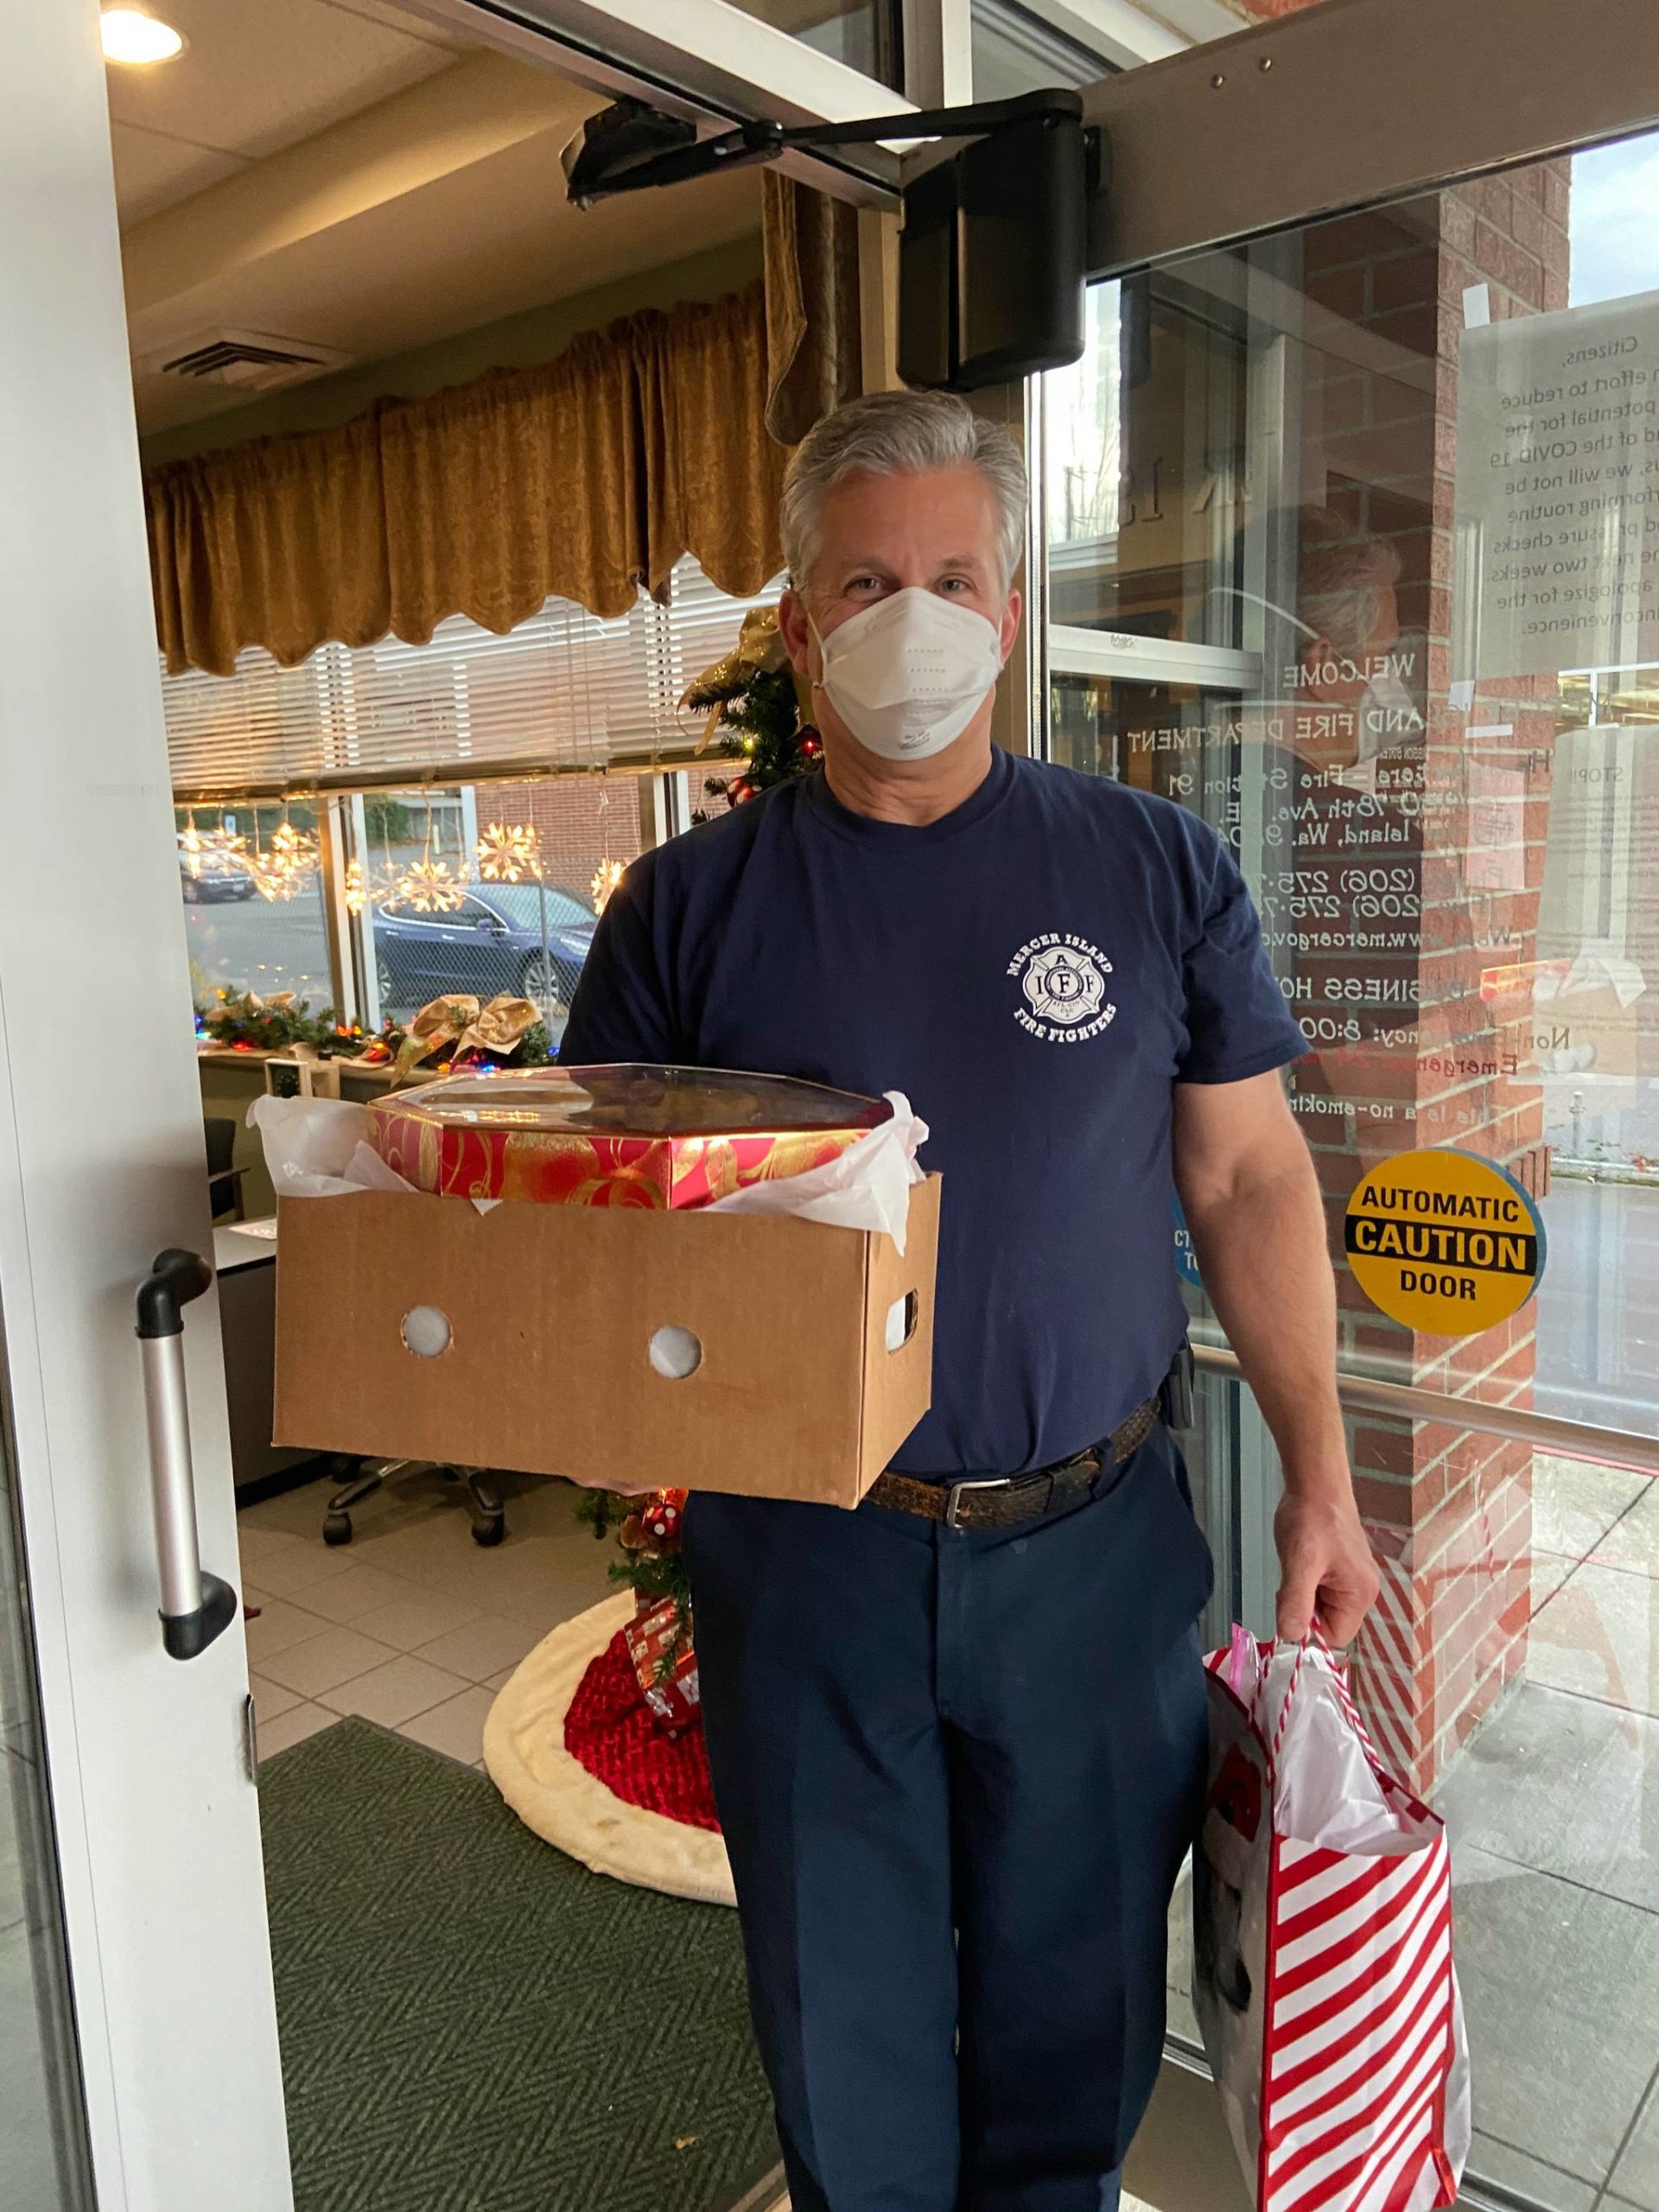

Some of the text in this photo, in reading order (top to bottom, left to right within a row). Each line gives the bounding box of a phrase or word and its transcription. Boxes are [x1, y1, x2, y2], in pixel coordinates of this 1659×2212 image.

[1007, 932, 1113, 976] MERCER ISLAND
[1014, 1002, 1116, 1043] FIRE FIGHTERS
[1362, 1185, 1519, 1223] AUTOMATIC
[1356, 1220, 1527, 1271] CAUTION
[1401, 1269, 1477, 1301] DOOR
